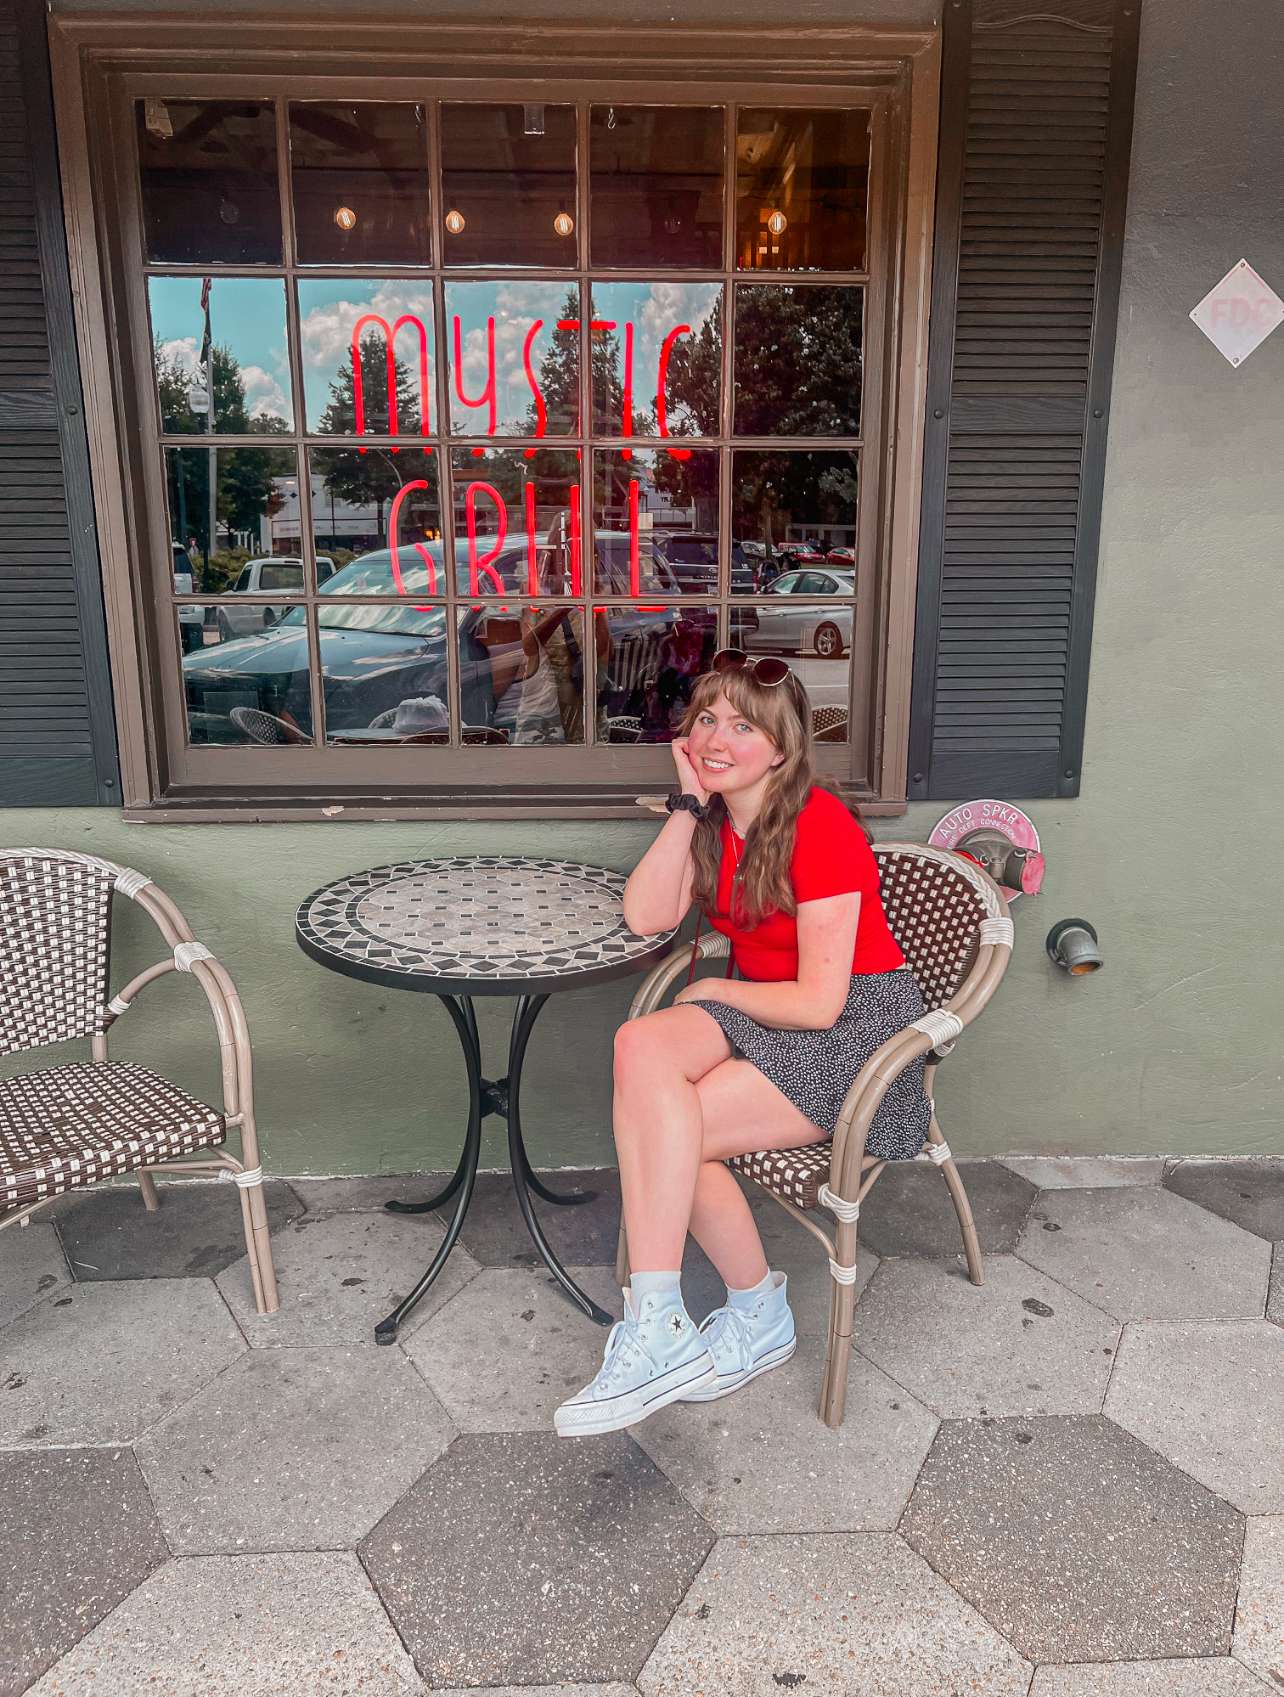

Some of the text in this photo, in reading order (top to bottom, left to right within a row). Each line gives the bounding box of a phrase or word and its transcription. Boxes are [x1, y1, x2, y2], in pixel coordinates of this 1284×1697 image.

[1211, 297, 1276, 327] FDC
[353, 314, 692, 461] MYSTIC
[389, 480, 668, 613] GRILL
[940, 804, 1018, 839] AUTO SPKR
